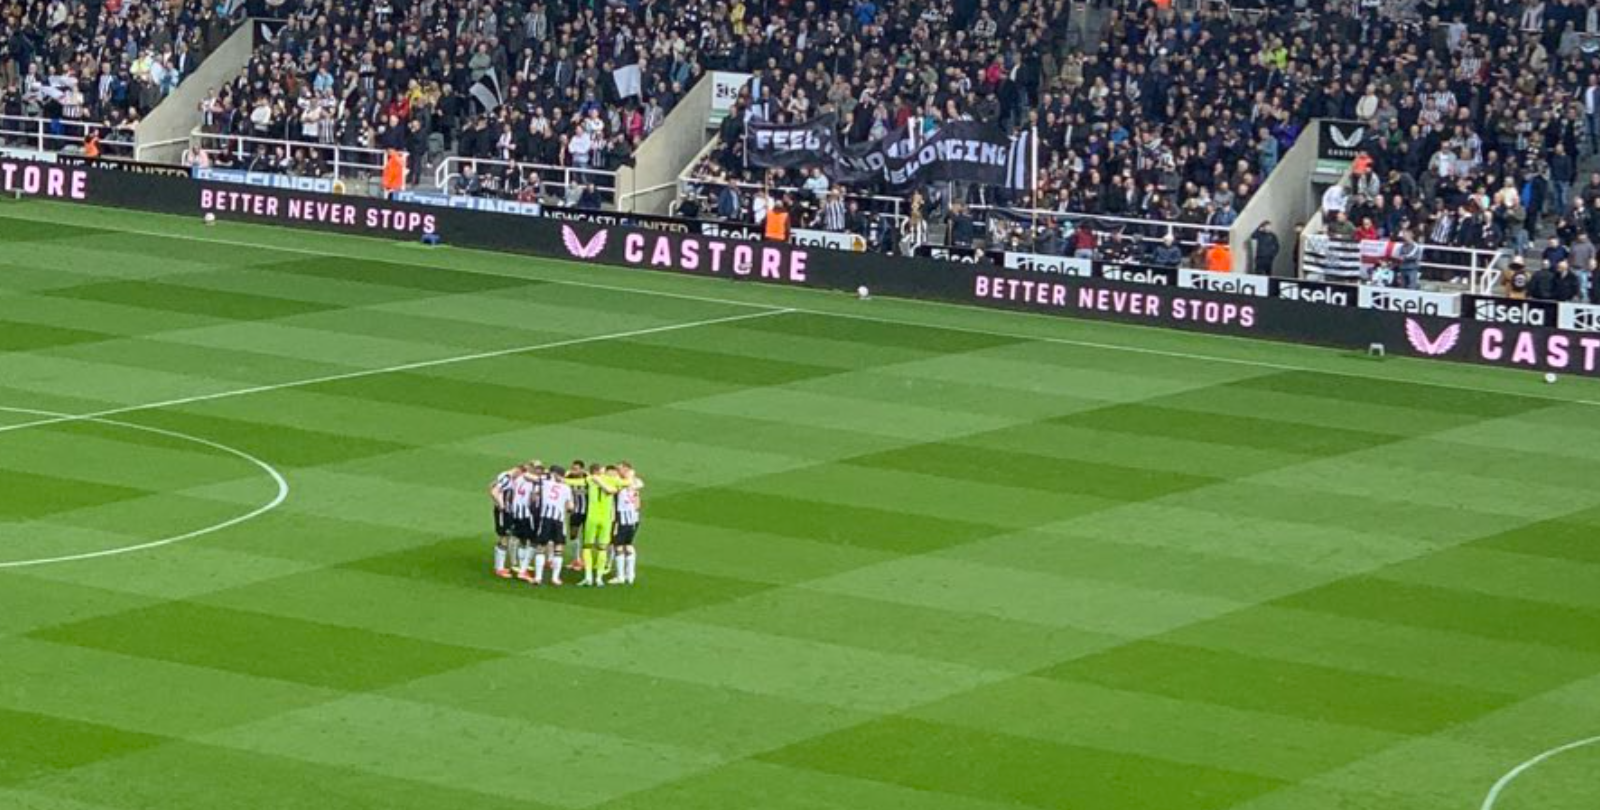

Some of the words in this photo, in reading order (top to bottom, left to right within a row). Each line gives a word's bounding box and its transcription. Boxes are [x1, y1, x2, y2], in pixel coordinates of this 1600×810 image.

[2, 163, 87, 199] TORE
[201, 189, 279, 216] BETTER
[288, 199, 355, 225] NEVER
[366, 208, 436, 234] STOPS
[624, 233, 807, 281] CASTORE
[975, 275, 1066, 305] BETTER
[1078, 288, 1160, 316] NEVER
[1172, 299, 1255, 327] STOPS
[1301, 286, 1347, 306] sela
[1394, 297, 1438, 316] sela
[1496, 302, 1545, 325] sela
[1481, 327, 1600, 371] CAST
[549, 485, 561, 501] 5
